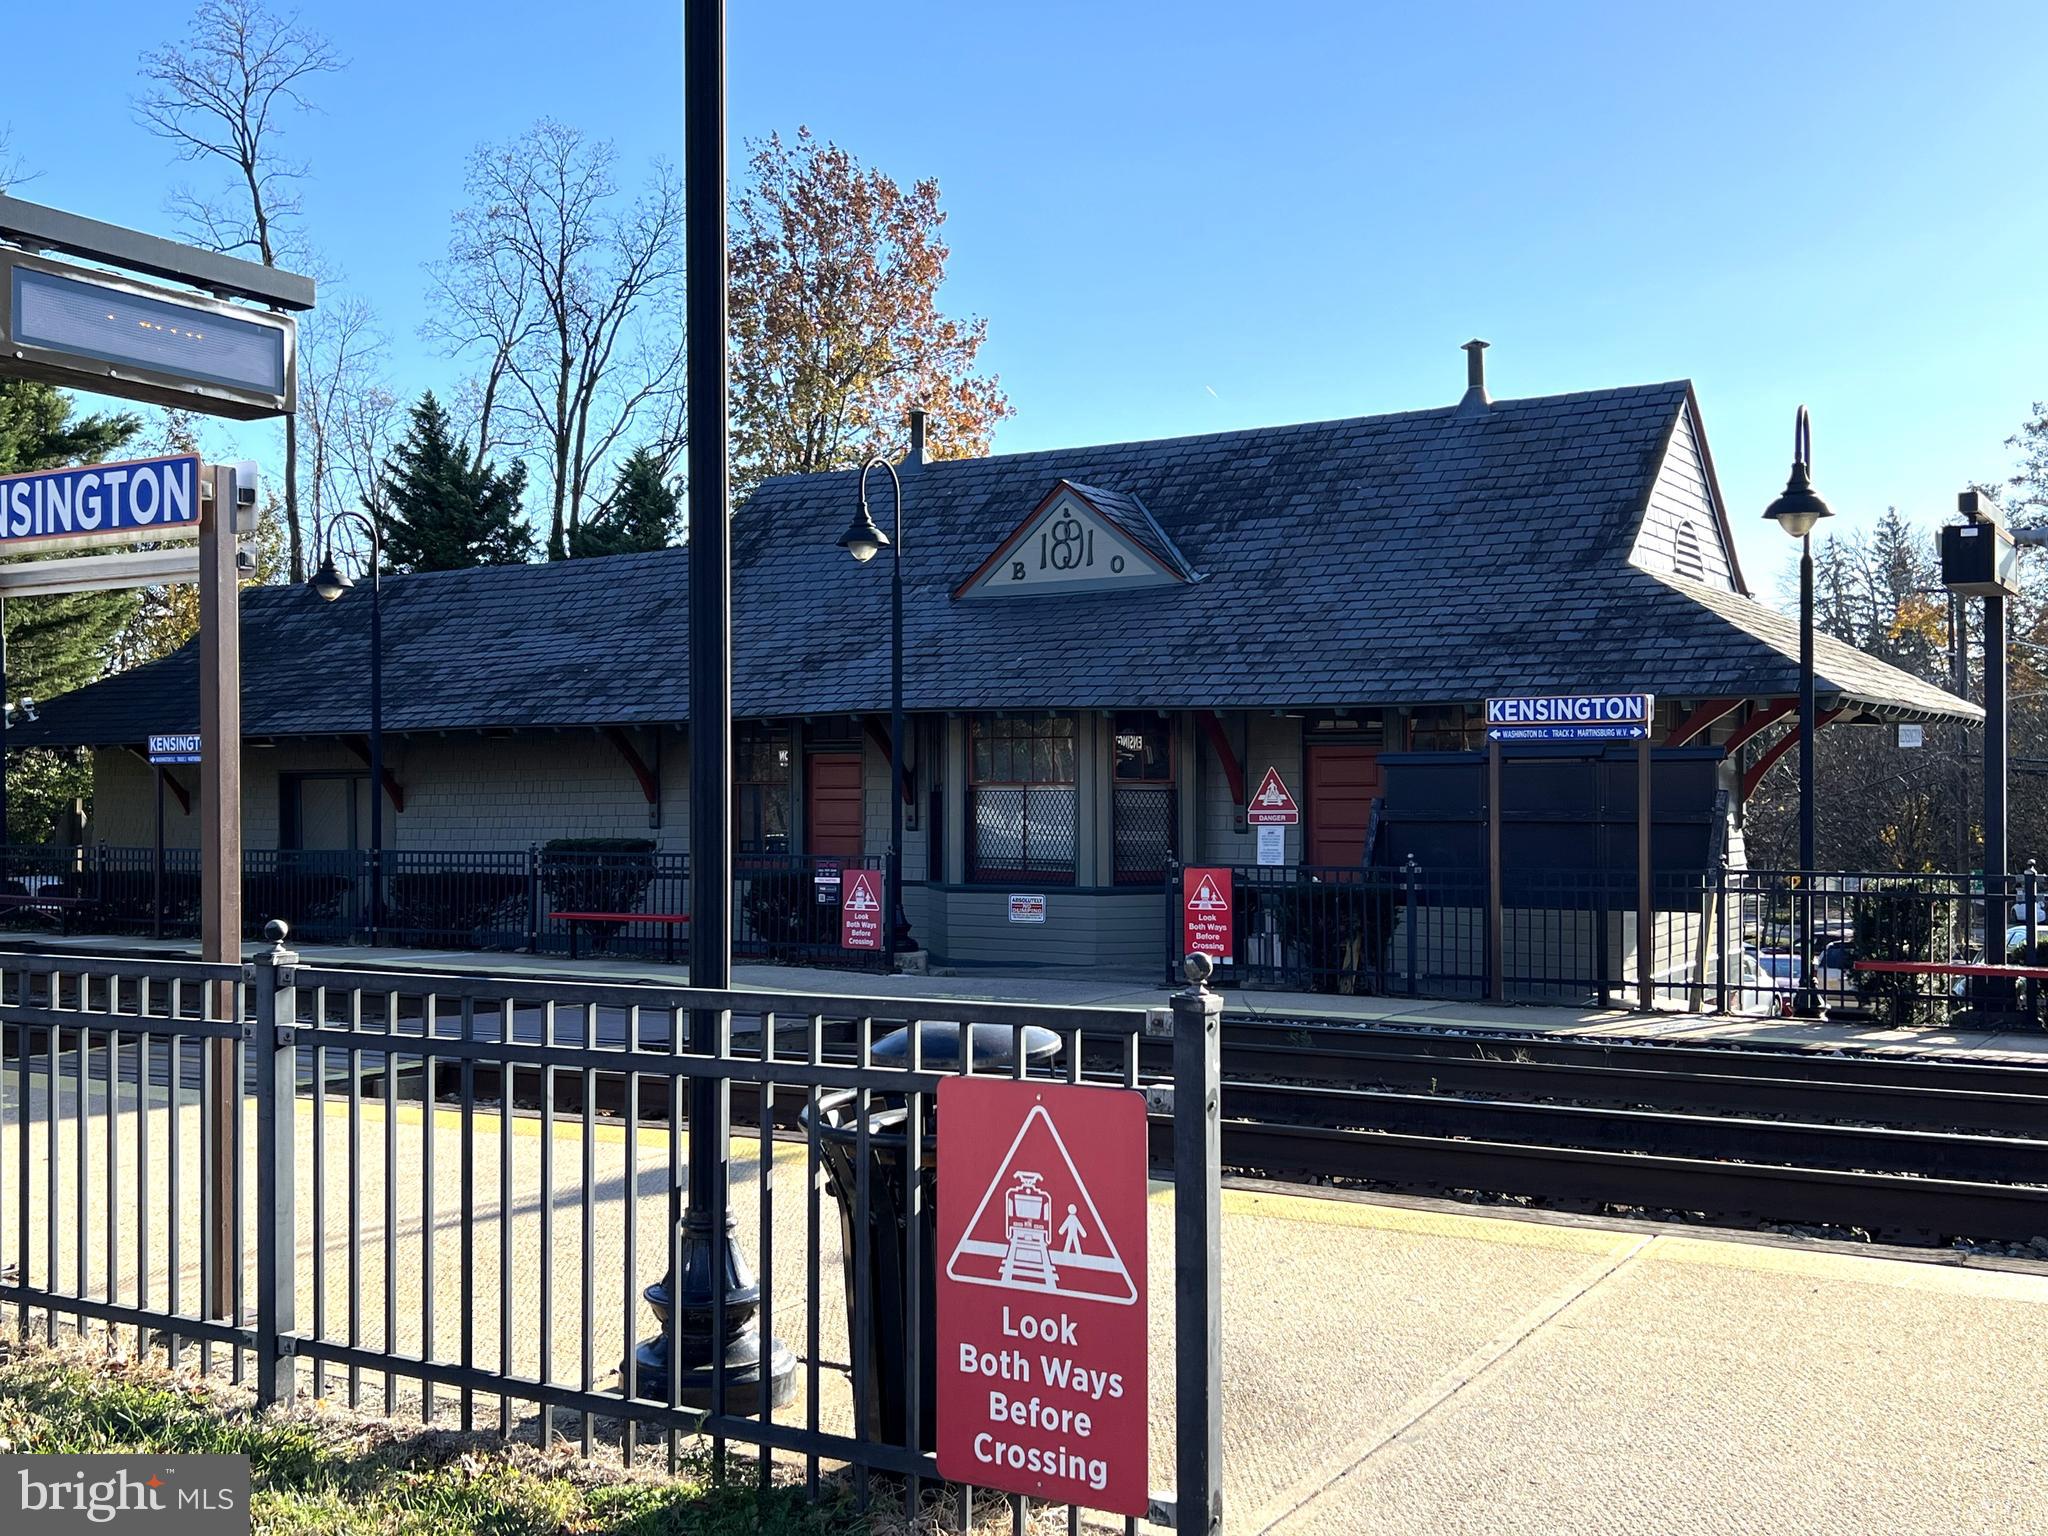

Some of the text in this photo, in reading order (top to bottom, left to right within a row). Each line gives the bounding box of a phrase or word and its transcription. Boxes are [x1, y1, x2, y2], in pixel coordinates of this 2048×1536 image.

[1063, 508, 1071, 518] &
[1040, 519, 1093, 570] 1891
[1011, 555, 1125, 580] B O
[1489, 697, 1641, 721] KENSINGTON
[1502, 730, 1537, 738] WASHINGTON
[1552, 730, 1569, 738] TRACK
[1570, 730, 1574, 738] 2
[1577, 729, 1615, 737] MARTINSBURG
[1616, 728, 1628, 736] W.V.
[150, 736, 202, 751] KENSINGT
[851, 929, 871, 937] Before
[861, 921, 877, 930] Ways
[1207, 923, 1227, 932] Ways
[848, 937, 874, 947] Crossing
[1192, 941, 1224, 951] Crossing
[1002, 1306, 1078, 1346] Look
[959, 1342, 1124, 1400] Both Ways
[989, 1390, 1092, 1437] Before
[974, 1432, 1108, 1490] Crossing
